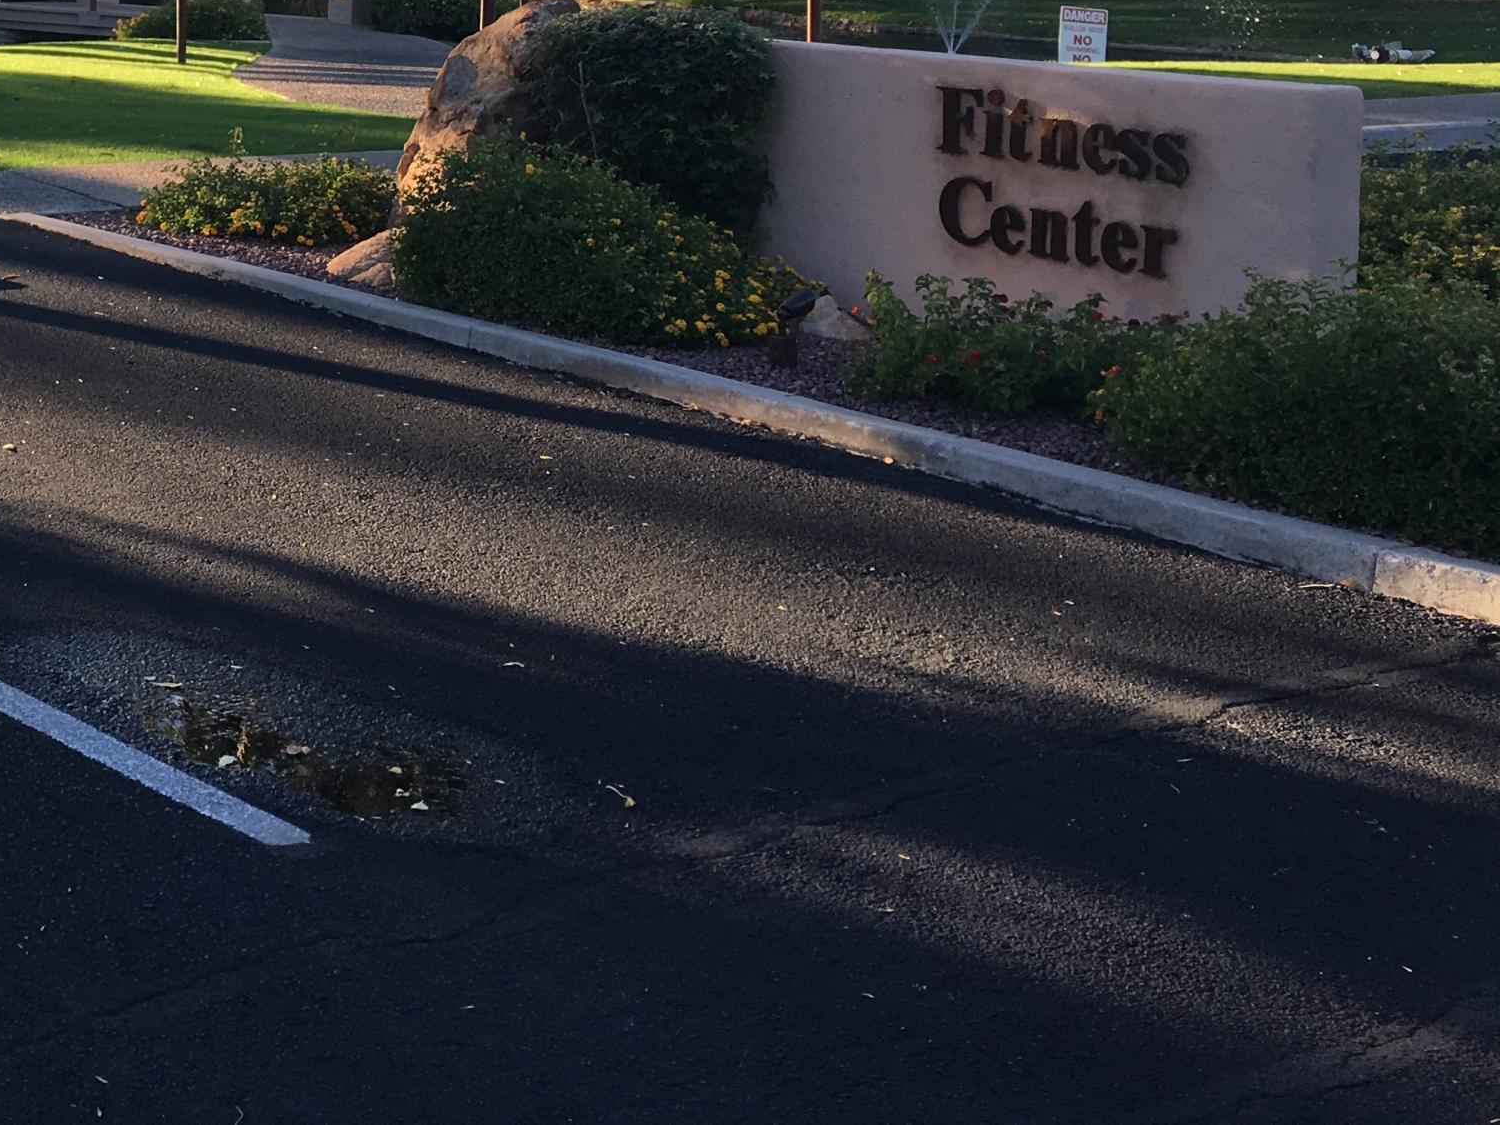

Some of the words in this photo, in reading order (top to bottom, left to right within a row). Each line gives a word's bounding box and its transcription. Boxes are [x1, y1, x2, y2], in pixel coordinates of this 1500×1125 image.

[1064, 9, 1105, 24] DANGER
[1073, 35, 1092, 46] NO
[1072, 54, 1092, 63] NO
[936, 86, 1190, 187] Fitness
[939, 176, 1179, 279] Center
